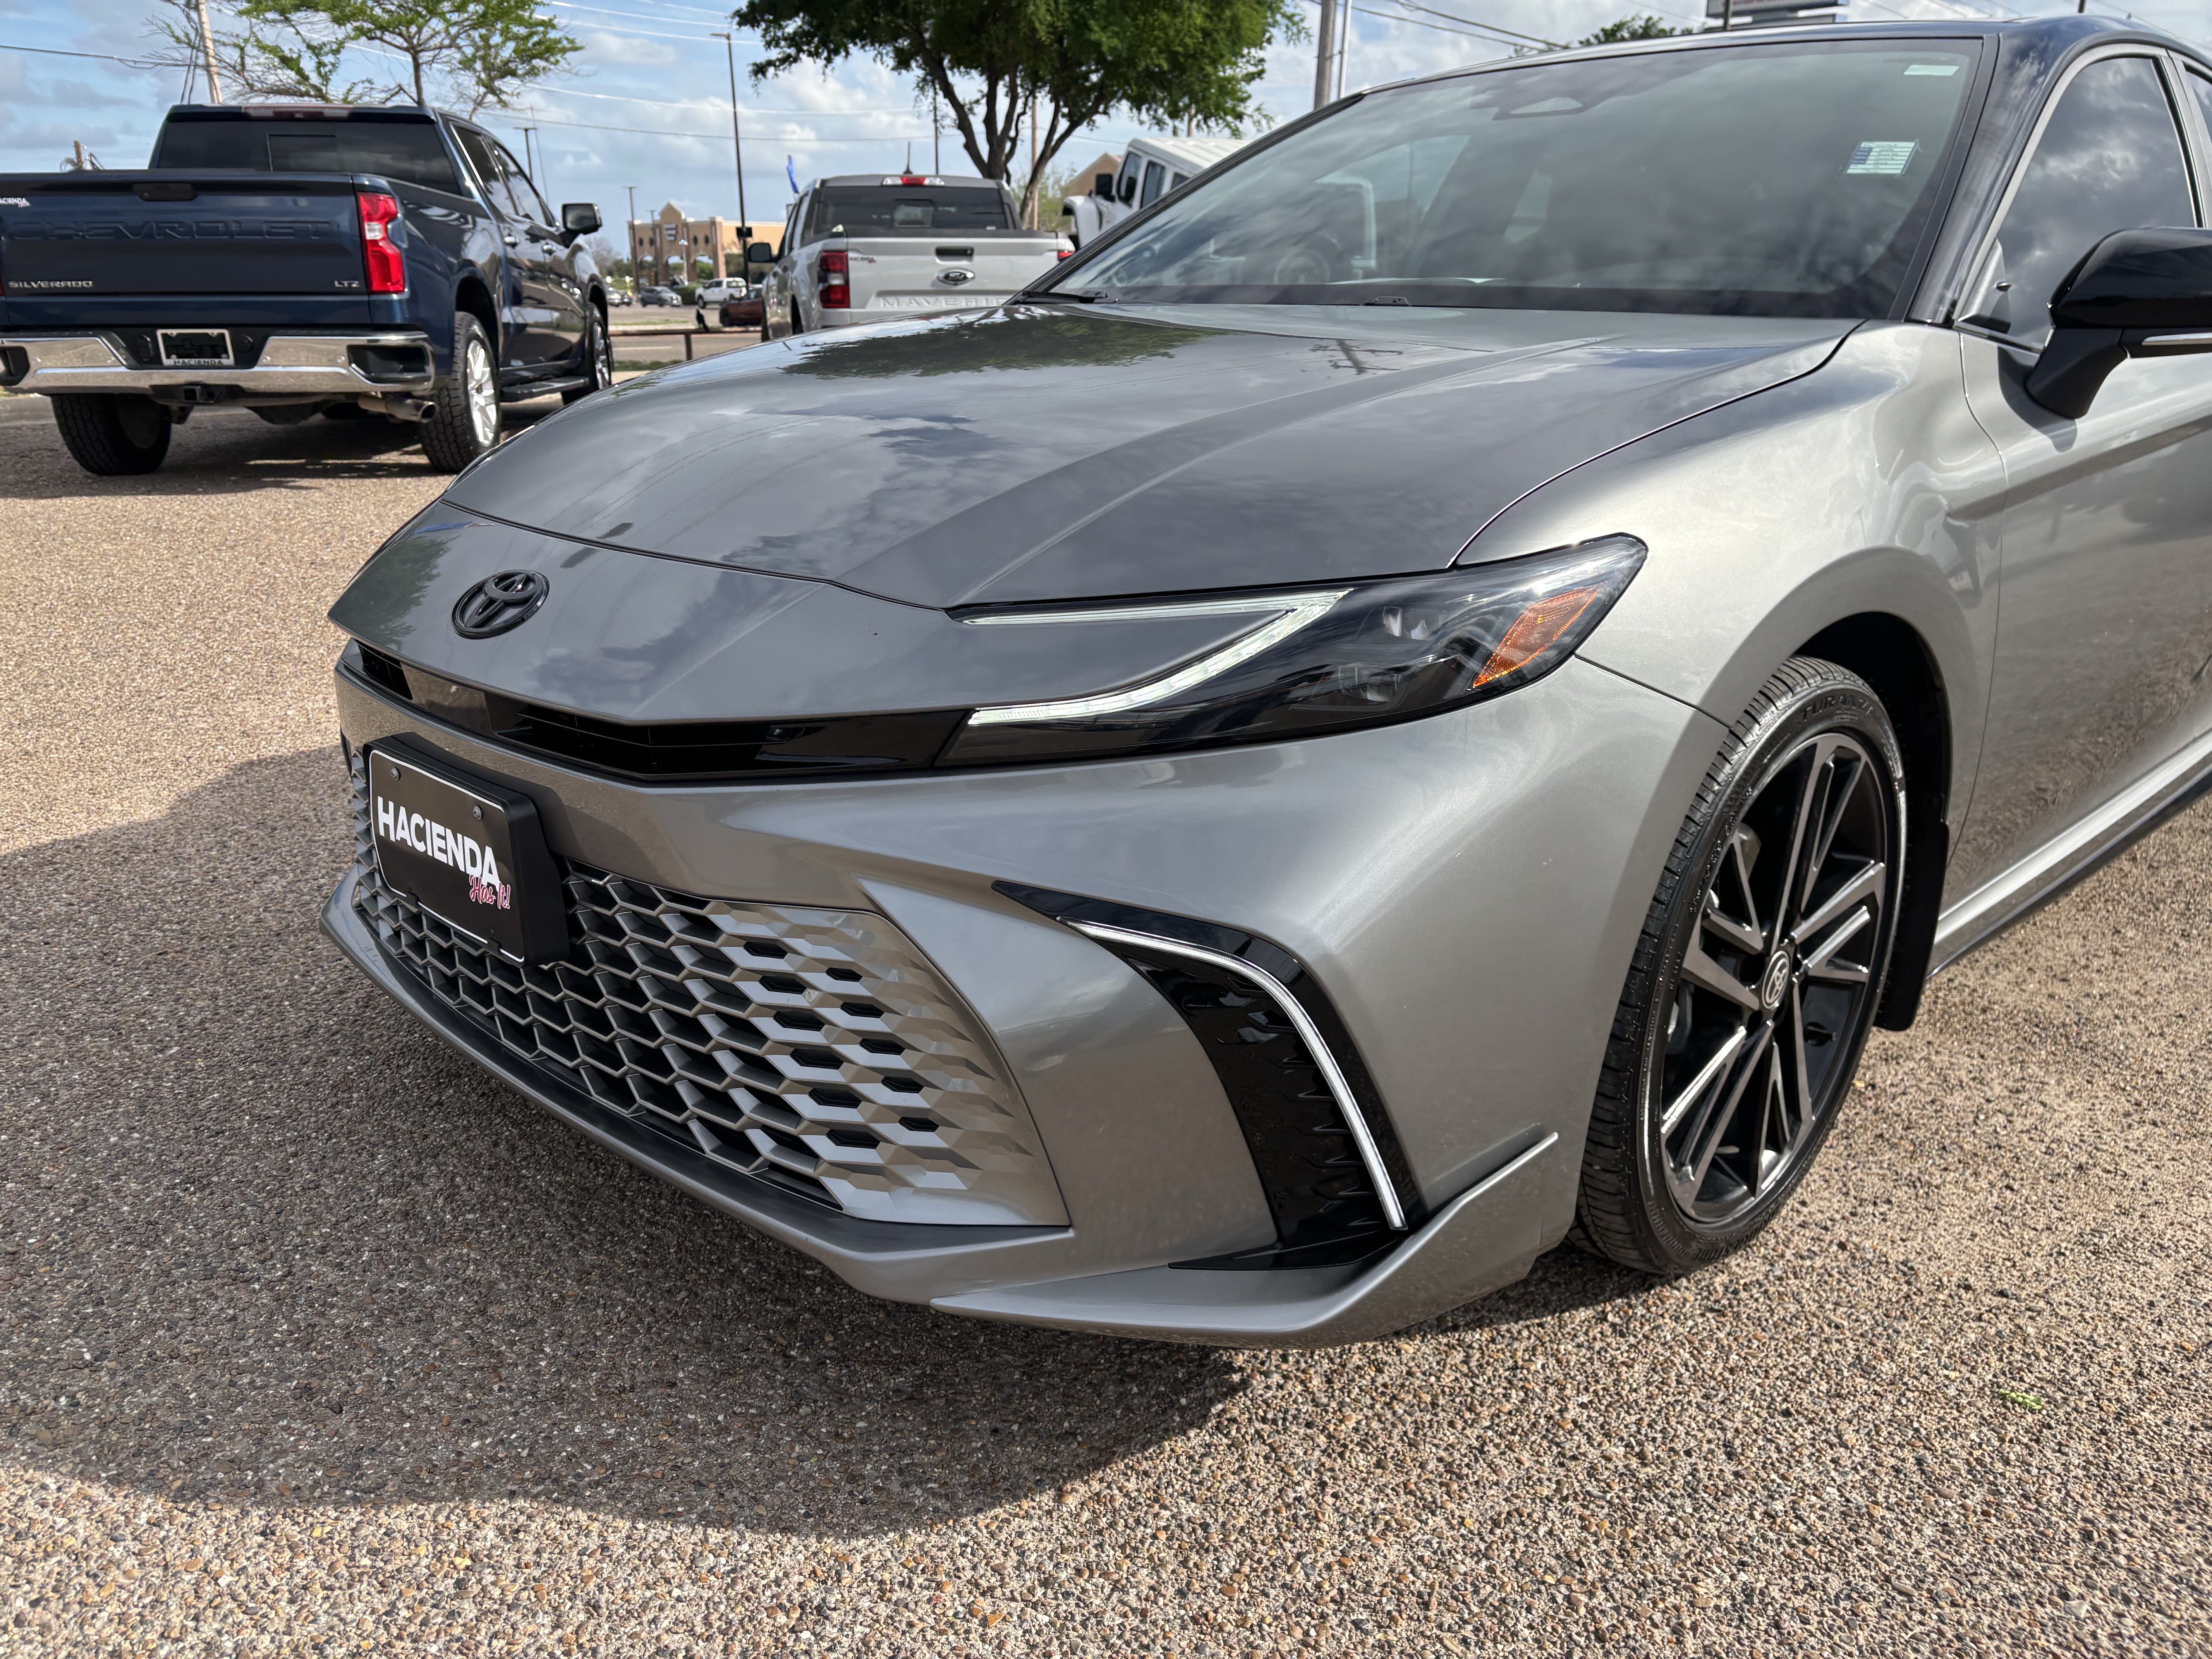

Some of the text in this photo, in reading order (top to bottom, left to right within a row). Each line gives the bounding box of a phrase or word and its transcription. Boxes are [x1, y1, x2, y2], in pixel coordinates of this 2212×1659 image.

[13, 221, 339, 240] CHEVROLET
[377, 796, 499, 892] HACIENDA
[469, 874, 510, 909] Has It!
